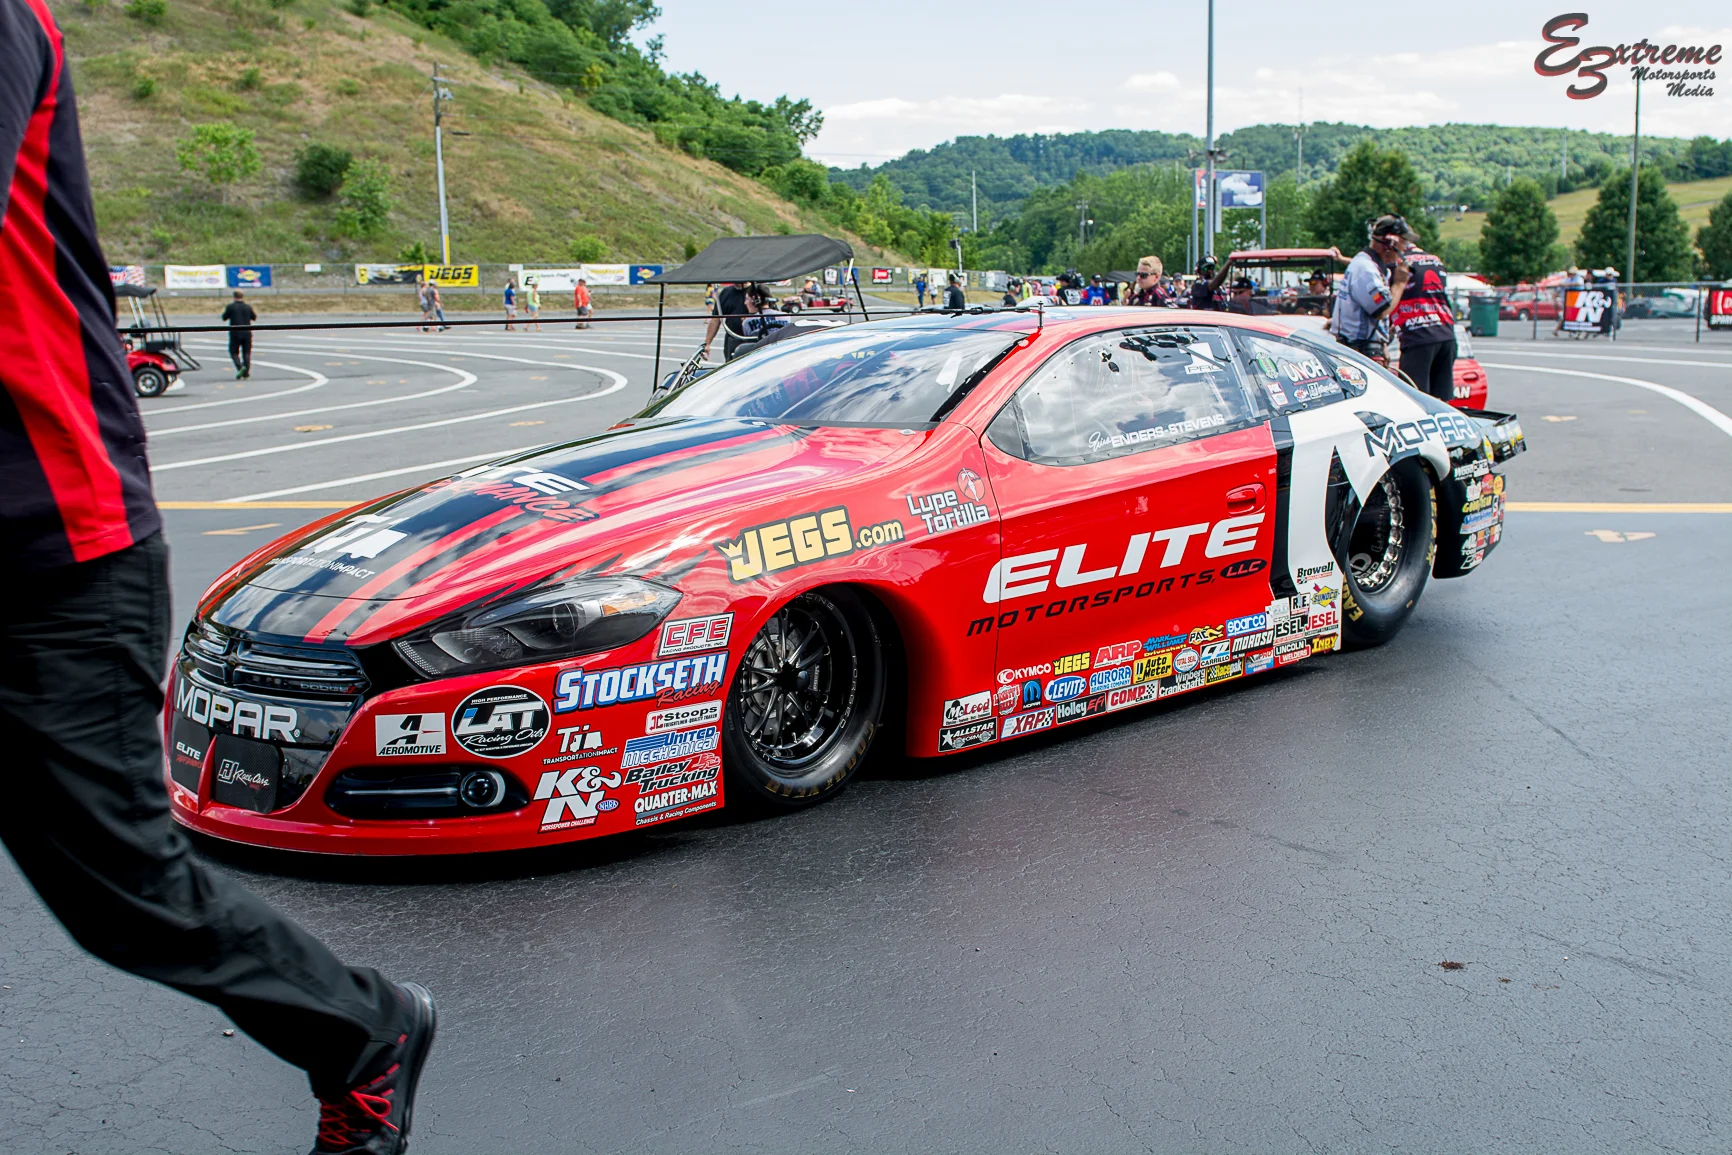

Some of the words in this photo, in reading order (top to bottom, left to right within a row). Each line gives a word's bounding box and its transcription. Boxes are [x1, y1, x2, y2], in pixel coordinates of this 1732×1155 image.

[429, 267, 473, 280] JEGS
[1111, 413, 1225, 448] ENDERS-STEVENS
[1364, 413, 1476, 457] MOPAR
[907, 491, 957, 515] Lupe
[922, 504, 990, 533] Tortilla
[982, 512, 1266, 604] ELITE
[1225, 560, 1263, 577] LLC
[1297, 561, 1335, 578] Browell
[1227, 613, 1266, 634] sparco
[1305, 611, 1339, 631] JESEL
[664, 619, 728, 646] CFE
[1189, 629, 1209, 643] PAC
[1231, 630, 1274, 653] MOROSO
[1094, 641, 1142, 666] ARP
[1275, 640, 1305, 655] LINCOLN
[1282, 649, 1308, 662] WELDERS
[1015, 663, 1052, 680] KYMCO
[1054, 651, 1092, 676] JEGS
[1145, 656, 1167, 670] Auto
[1201, 655, 1230, 667] CARRILLO
[555, 654, 728, 712] STOCKSETH
[1090, 666, 1132, 687] AURORA
[1142, 664, 1171, 682] Meter
[1175, 669, 1205, 684] Winberg
[486, 693, 528, 702] PERFORMANCE
[655, 680, 722, 707] Racing
[1110, 685, 1147, 707] COMP
[176, 677, 297, 743] MOPAR
[455, 701, 544, 736] LAT
[663, 706, 718, 722] Stoops
[946, 699, 990, 720] McLeod
[1057, 704, 1087, 719] Holley
[952, 721, 995, 738] ALLSTAR
[1011, 711, 1046, 735] XRP
[462, 734, 513, 747] Racing
[515, 728, 544, 741] Oils
[176, 741, 201, 761] ELITE
[378, 745, 442, 756] AEROMOTIVE
[542, 747, 619, 765] TRANSPORTATIONIMPACT
[533, 765, 623, 800] K&
[624, 759, 693, 785] Bailey
[639, 766, 720, 795] Trucking
[541, 790, 606, 824] N
[635, 816, 659, 826] Chassis
[664, 809, 684, 819] Racing
[684, 801, 717, 815] Components
